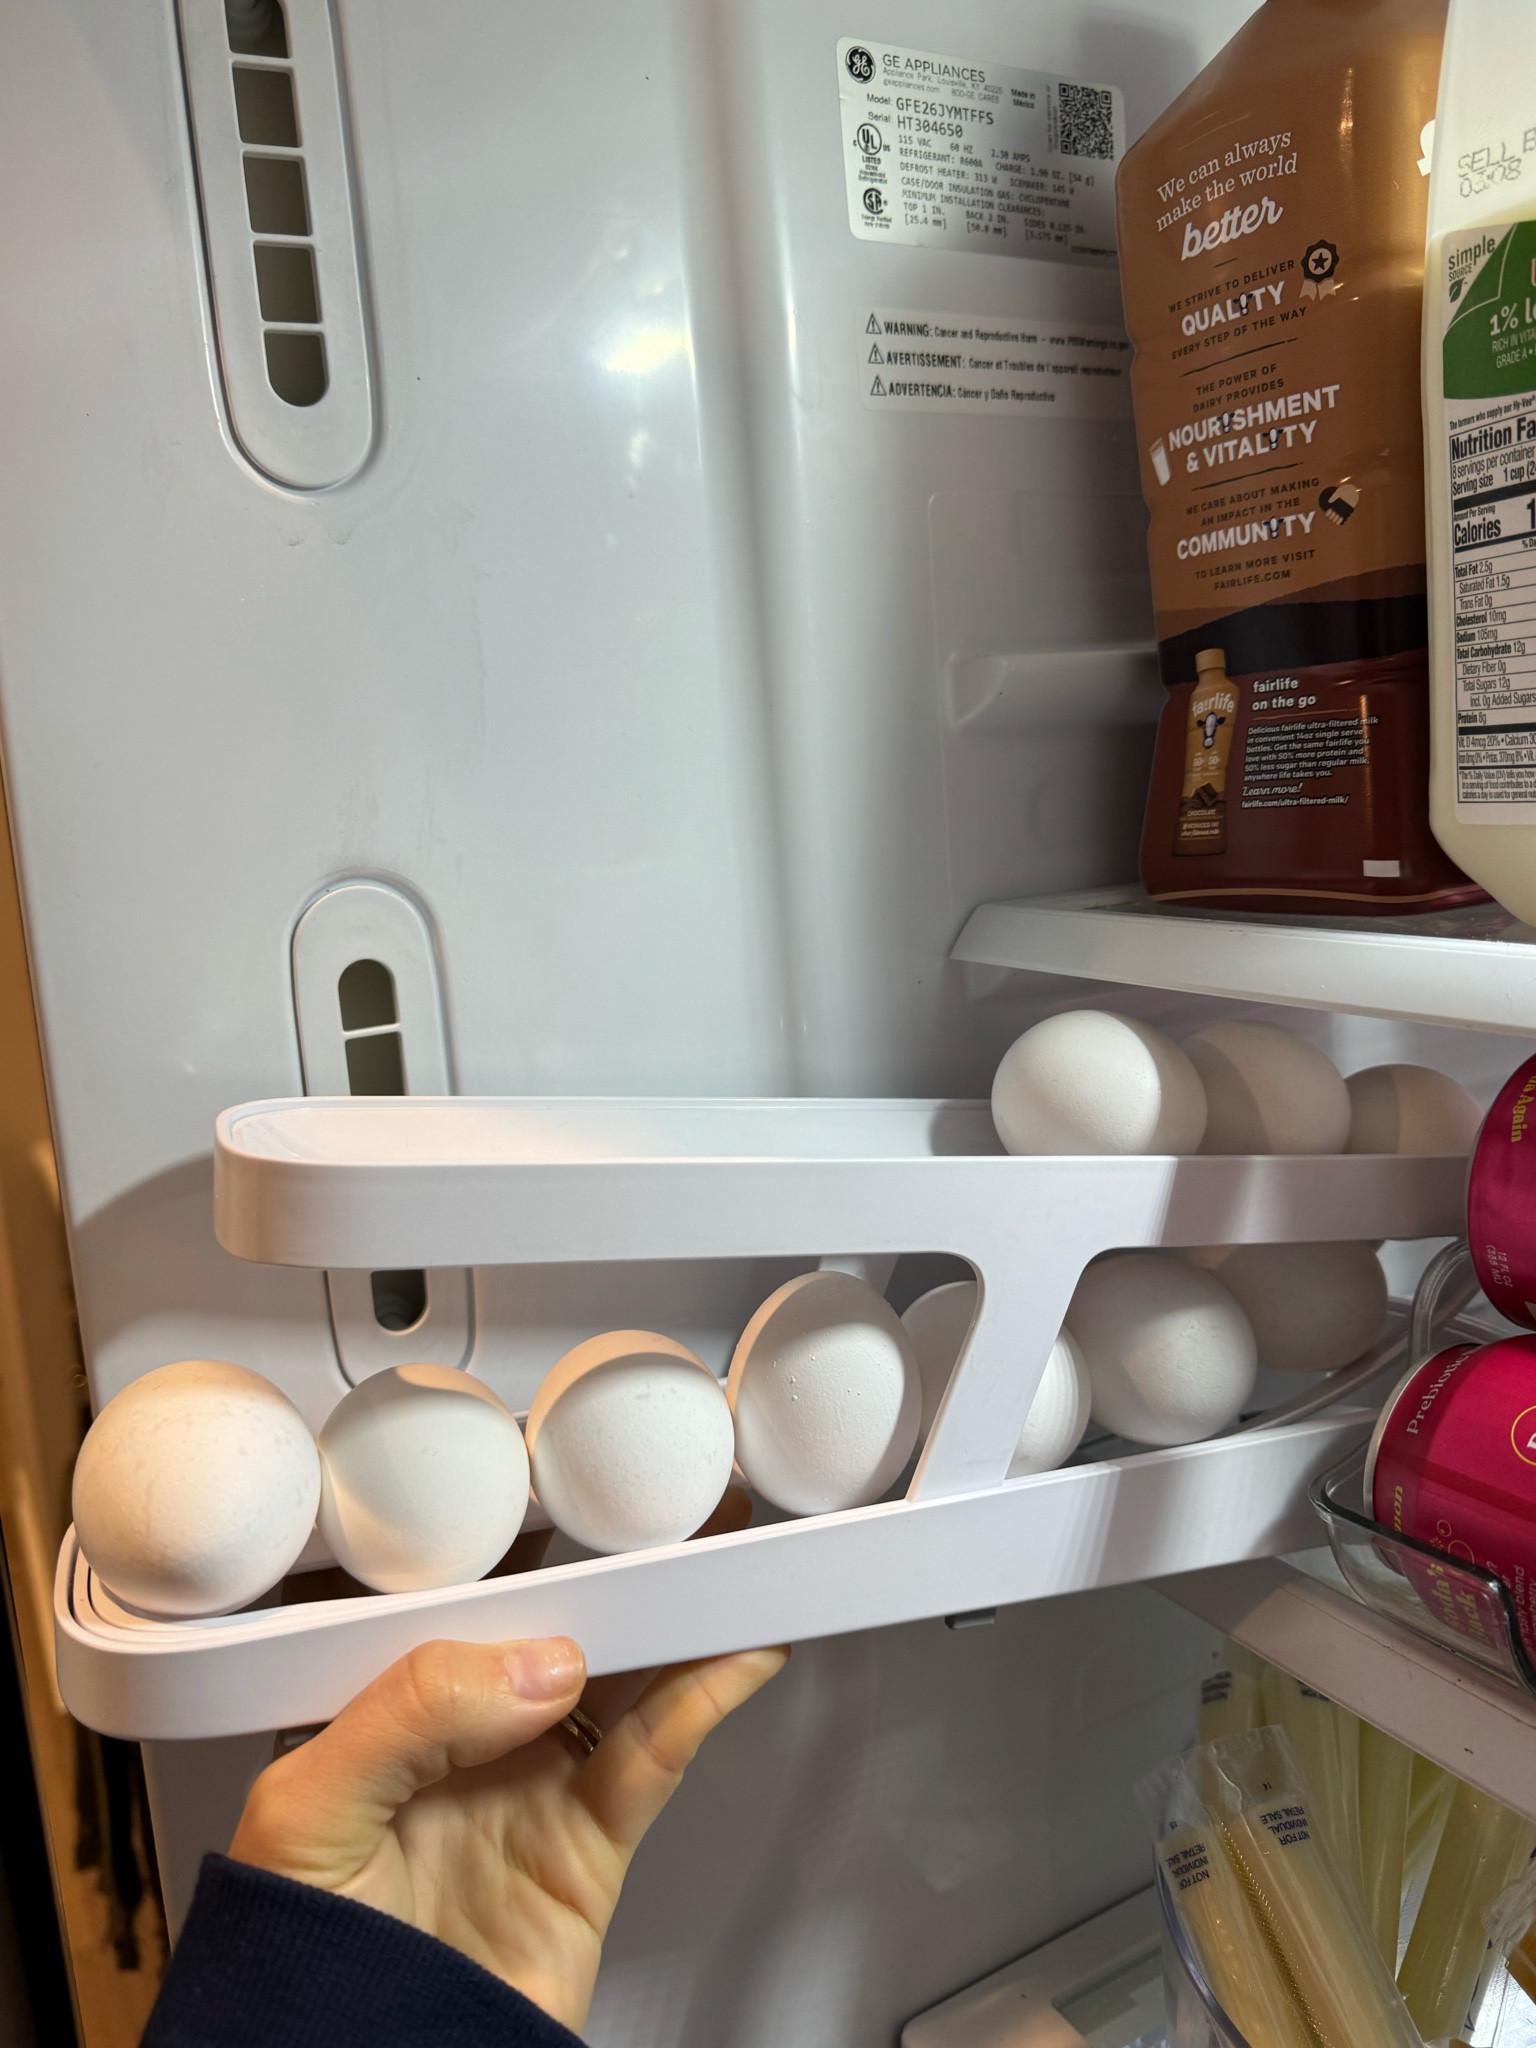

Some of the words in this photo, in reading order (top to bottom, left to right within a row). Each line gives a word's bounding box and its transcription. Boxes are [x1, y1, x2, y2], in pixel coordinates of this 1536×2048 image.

[883, 54, 900, 68] GE
[905, 58, 985, 83] APPLIANCES
[867, 93, 893, 106] Model:
[896, 97, 994, 125] GFE26JYMTFFS
[868, 112, 893, 123] Serial:
[897, 115, 963, 138] HT304650
[899, 135, 913, 145] 115
[917, 138, 932, 148] VAC
[963, 145, 973, 154] HZ
[899, 147, 955, 164] REFRIGERANT:
[1458, 142, 1515, 172] SELL
[900, 162, 933, 174] DEFROST
[937, 167, 969, 180] HEATER:
[1156, 178, 1186, 203] We
[1189, 158, 1221, 185] can
[1224, 131, 1292, 167] always
[901, 176, 944, 190] CASE/DOOR
[948, 183, 994, 198] INSULATION
[1156, 194, 1201, 232] make
[1205, 178, 1235, 202] the
[1239, 152, 1298, 187] world
[902, 189, 937, 202] MINIMUM
[940, 194, 994, 210] INSTALLATION
[904, 202, 918, 212] TOP
[1180, 196, 1284, 261] better
[1448, 235, 1495, 270] simple
[1448, 263, 1472, 282] SOURCE
[1169, 299, 1182, 313] WE
[1185, 285, 1222, 307] STRIVE
[1225, 278, 1240, 291] TO
[1243, 260, 1295, 285] DELIVER
[1490, 303, 1518, 336] 1%
[884, 321, 934, 338] WARNING:
[935, 326, 958, 337] Cancer
[1171, 342, 1201, 360] EVERY
[1204, 331, 1230, 348] STEP
[1234, 325, 1249, 337] OF
[1252, 316, 1276, 332] THE
[1280, 306, 1307, 323] WAY
[1492, 338, 1509, 353] RICH
[1510, 334, 1519, 347] IN
[886, 351, 966, 369] AVERTISSEMENT:
[1496, 349, 1521, 369] GRADE
[1522, 346, 1528, 360] A
[1196, 383, 1215, 396] THE
[1218, 370, 1257, 389] POWER
[1261, 364, 1277, 376] OF
[888, 382, 956, 398] ADVERTENCIA:
[1193, 396, 1222, 413] DAIRY
[1226, 378, 1285, 402] PROVIDES
[1451, 425, 1512, 460] Nutrition
[1186, 451, 1200, 473] &
[1452, 464, 1458, 480] 8
[1457, 458, 1485, 478] servings
[1486, 456, 1499, 470] per
[1500, 446, 1536, 466] container
[1453, 478, 1478, 497] Serving
[1479, 474, 1494, 487] size
[1503, 467, 1509, 482] 1
[1510, 465, 1525, 481] cup
[1185, 505, 1199, 516] WE
[1201, 497, 1226, 512] CARE
[1229, 489, 1266, 505] ABOUT
[1270, 477, 1320, 495] MAKING
[1201, 517, 1214, 527] AN
[1217, 507, 1256, 523] IMPACT
[1260, 502, 1272, 513] IN
[1276, 497, 1300, 510] THE
[1469, 508, 1477, 519] Per
[1478, 505, 1496, 517] Serving
[1454, 517, 1501, 546] Calories
[1195, 570, 1207, 581] TO
[1209, 561, 1242, 577] LEARN
[1245, 556, 1278, 572] MORE
[1282, 549, 1316, 563] VISIT
[1454, 565, 1468, 578] Total
[1468, 563, 1479, 576] Fat
[1479, 561, 1493, 575] 2.5g
[1214, 569, 1291, 591] FAIRLIFE.COM
[1459, 578, 1485, 595] Saturated
[1486, 577, 1495, 591] Fat
[1496, 574, 1510, 588] 1.5g
[1460, 598, 1473, 610] Trans
[1474, 596, 1484, 608] Fat
[1485, 594, 1493, 608] 0g
[1456, 611, 1487, 627] Cholesterol
[1488, 610, 1507, 623] 10mg
[1456, 631, 1476, 644] Sodium
[1477, 628, 1498, 641] 105mg
[1457, 647, 1469, 660] Total
[1470, 642, 1512, 658] Carbohydrate
[1513, 640, 1526, 655] 12g
[1462, 662, 1480, 676] Dietary
[1482, 661, 1496, 674] Fiber
[1497, 660, 1506, 674] 0g
[1252, 677, 1299, 693] fairlife
[1463, 679, 1476, 692] Total
[1476, 678, 1497, 691] Sugars
[1499, 676, 1510, 690] 12g
[1252, 699, 1268, 711] on
[1271, 695, 1295, 709] the
[1298, 694, 1317, 709] go
[1492, 693, 1512, 706] Added
[1248, 724, 1280, 735] Delicious
[1281, 721, 1306, 732] fairlife
[1307, 717, 1358, 730] ultra-filtered
[1360, 716, 1379, 726] milk
[1458, 713, 1477, 724] Protein
[1479, 712, 1487, 725] 8g
[1254, 733, 1295, 744] convenient
[1296, 731, 1314, 740] 14oz
[1315, 729, 1339, 740] single
[1341, 728, 1364, 737] serve
[1274, 742, 1288, 751] Get
[1289, 741, 1302, 750] the
[1303, 740, 1324, 749] same
[1325, 737, 1353, 747] fairlife
[1354, 737, 1370, 747] you
[1505, 734, 1528, 746] Calcium
[1261, 752, 1277, 761] with
[1278, 751, 1294, 760] 50%
[1295, 750, 1316, 759] more
[1317, 748, 1347, 760] protein
[1348, 746, 1364, 756] and
[1260, 761, 1275, 771] less
[1276, 761, 1298, 772] sugar
[1299, 758, 1317, 768] than
[1318, 755, 1348, 767] regular
[1349, 756, 1370, 766] milk.
[1279, 770, 1291, 779] life
[1292, 769, 1314, 778] takes
[1315, 768, 1333, 779] you.
[1242, 785, 1271, 796] Learn
[1272, 782, 1303, 795] more!
[1241, 795, 1349, 809] fairlife.com/ultra-filtered-milk/
[1511, 1094, 1535, 1143] Again
[1514, 1564, 1526, 1606] blend
[1260, 1810, 1283, 1825] SALE
[1279, 1833, 1297, 1847] FOR
[1191, 1869, 1210, 1883] NOT
